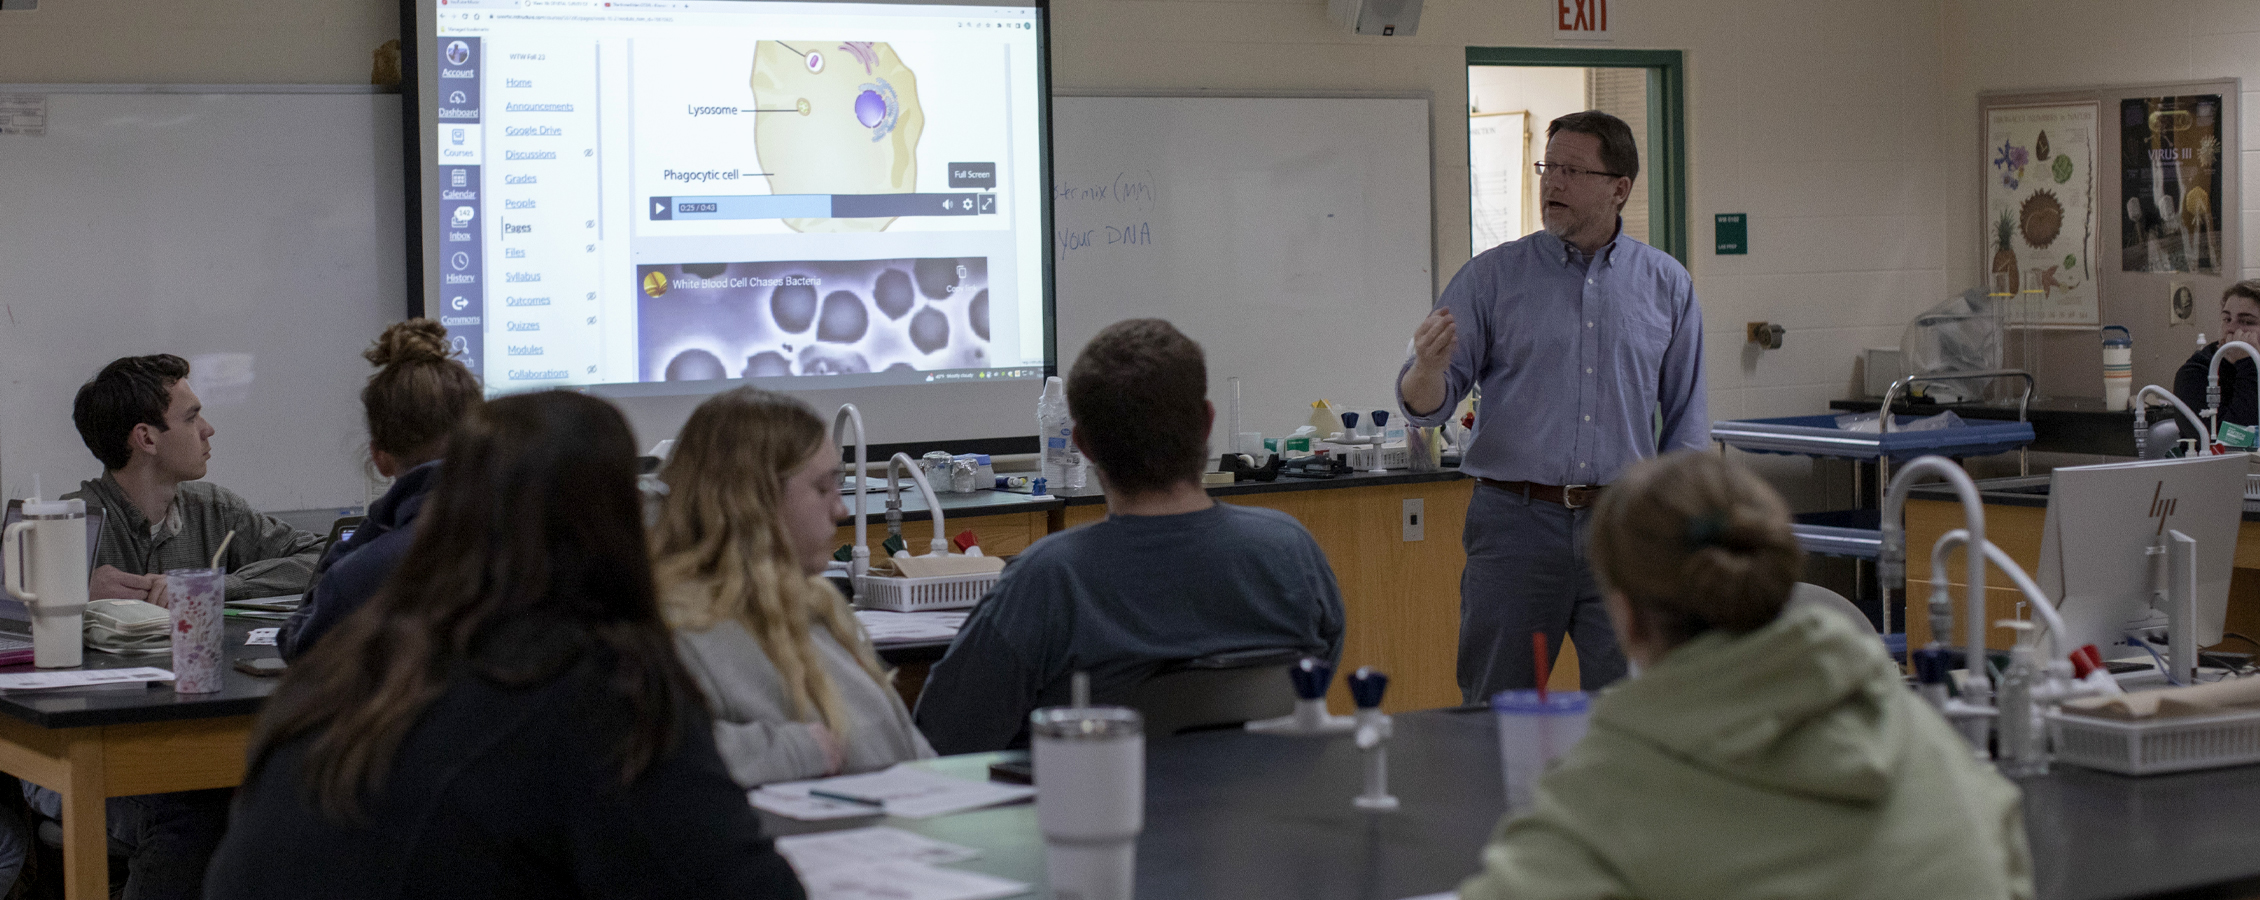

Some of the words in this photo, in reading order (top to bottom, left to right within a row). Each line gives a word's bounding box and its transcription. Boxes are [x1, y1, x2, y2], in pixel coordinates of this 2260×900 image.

[1558, 0, 1607, 31] EXIT
[442, 68, 474, 78] Account
[506, 78, 532, 88] Home
[505, 102, 574, 111] Announcements
[688, 104, 738, 117] Lysosome
[438, 108, 479, 118] Dashboard
[505, 126, 537, 136] Google
[540, 126, 562, 136] Drive
[443, 149, 474, 157] Courses
[505, 150, 556, 160] Discussions
[2148, 148, 2179, 160] VIRUS
[505, 174, 537, 184] Grades
[664, 169, 720, 183] Phagocytic
[722, 169, 739, 180] cell
[954, 170, 966, 178] Full
[967, 170, 990, 178] Screen
[443, 189, 476, 199] Calendar
[505, 198, 536, 209] People
[680, 204, 695, 212] 0:25
[700, 204, 716, 212] 0:43
[505, 223, 532, 234] Pages
[450, 231, 471, 241] Inbox
[1058, 227, 1095, 261] your
[1105, 221, 1151, 246] DNA
[505, 248, 526, 258] Files
[446, 273, 475, 283] History
[506, 272, 541, 282] Syllabus
[672, 279, 700, 289] White
[701, 278, 728, 289] Blood
[730, 277, 748, 288] Cell
[750, 277, 784, 287] Chases
[785, 276, 822, 286] Bacteria
[946, 285, 964, 294] Copy
[506, 296, 551, 307] Outcomes
[441, 315, 480, 326] Commons
[507, 320, 540, 331] Quizzes
[508, 345, 544, 355] Modules
[508, 369, 569, 380] Collaborations
[2149, 480, 2177, 536] hp
